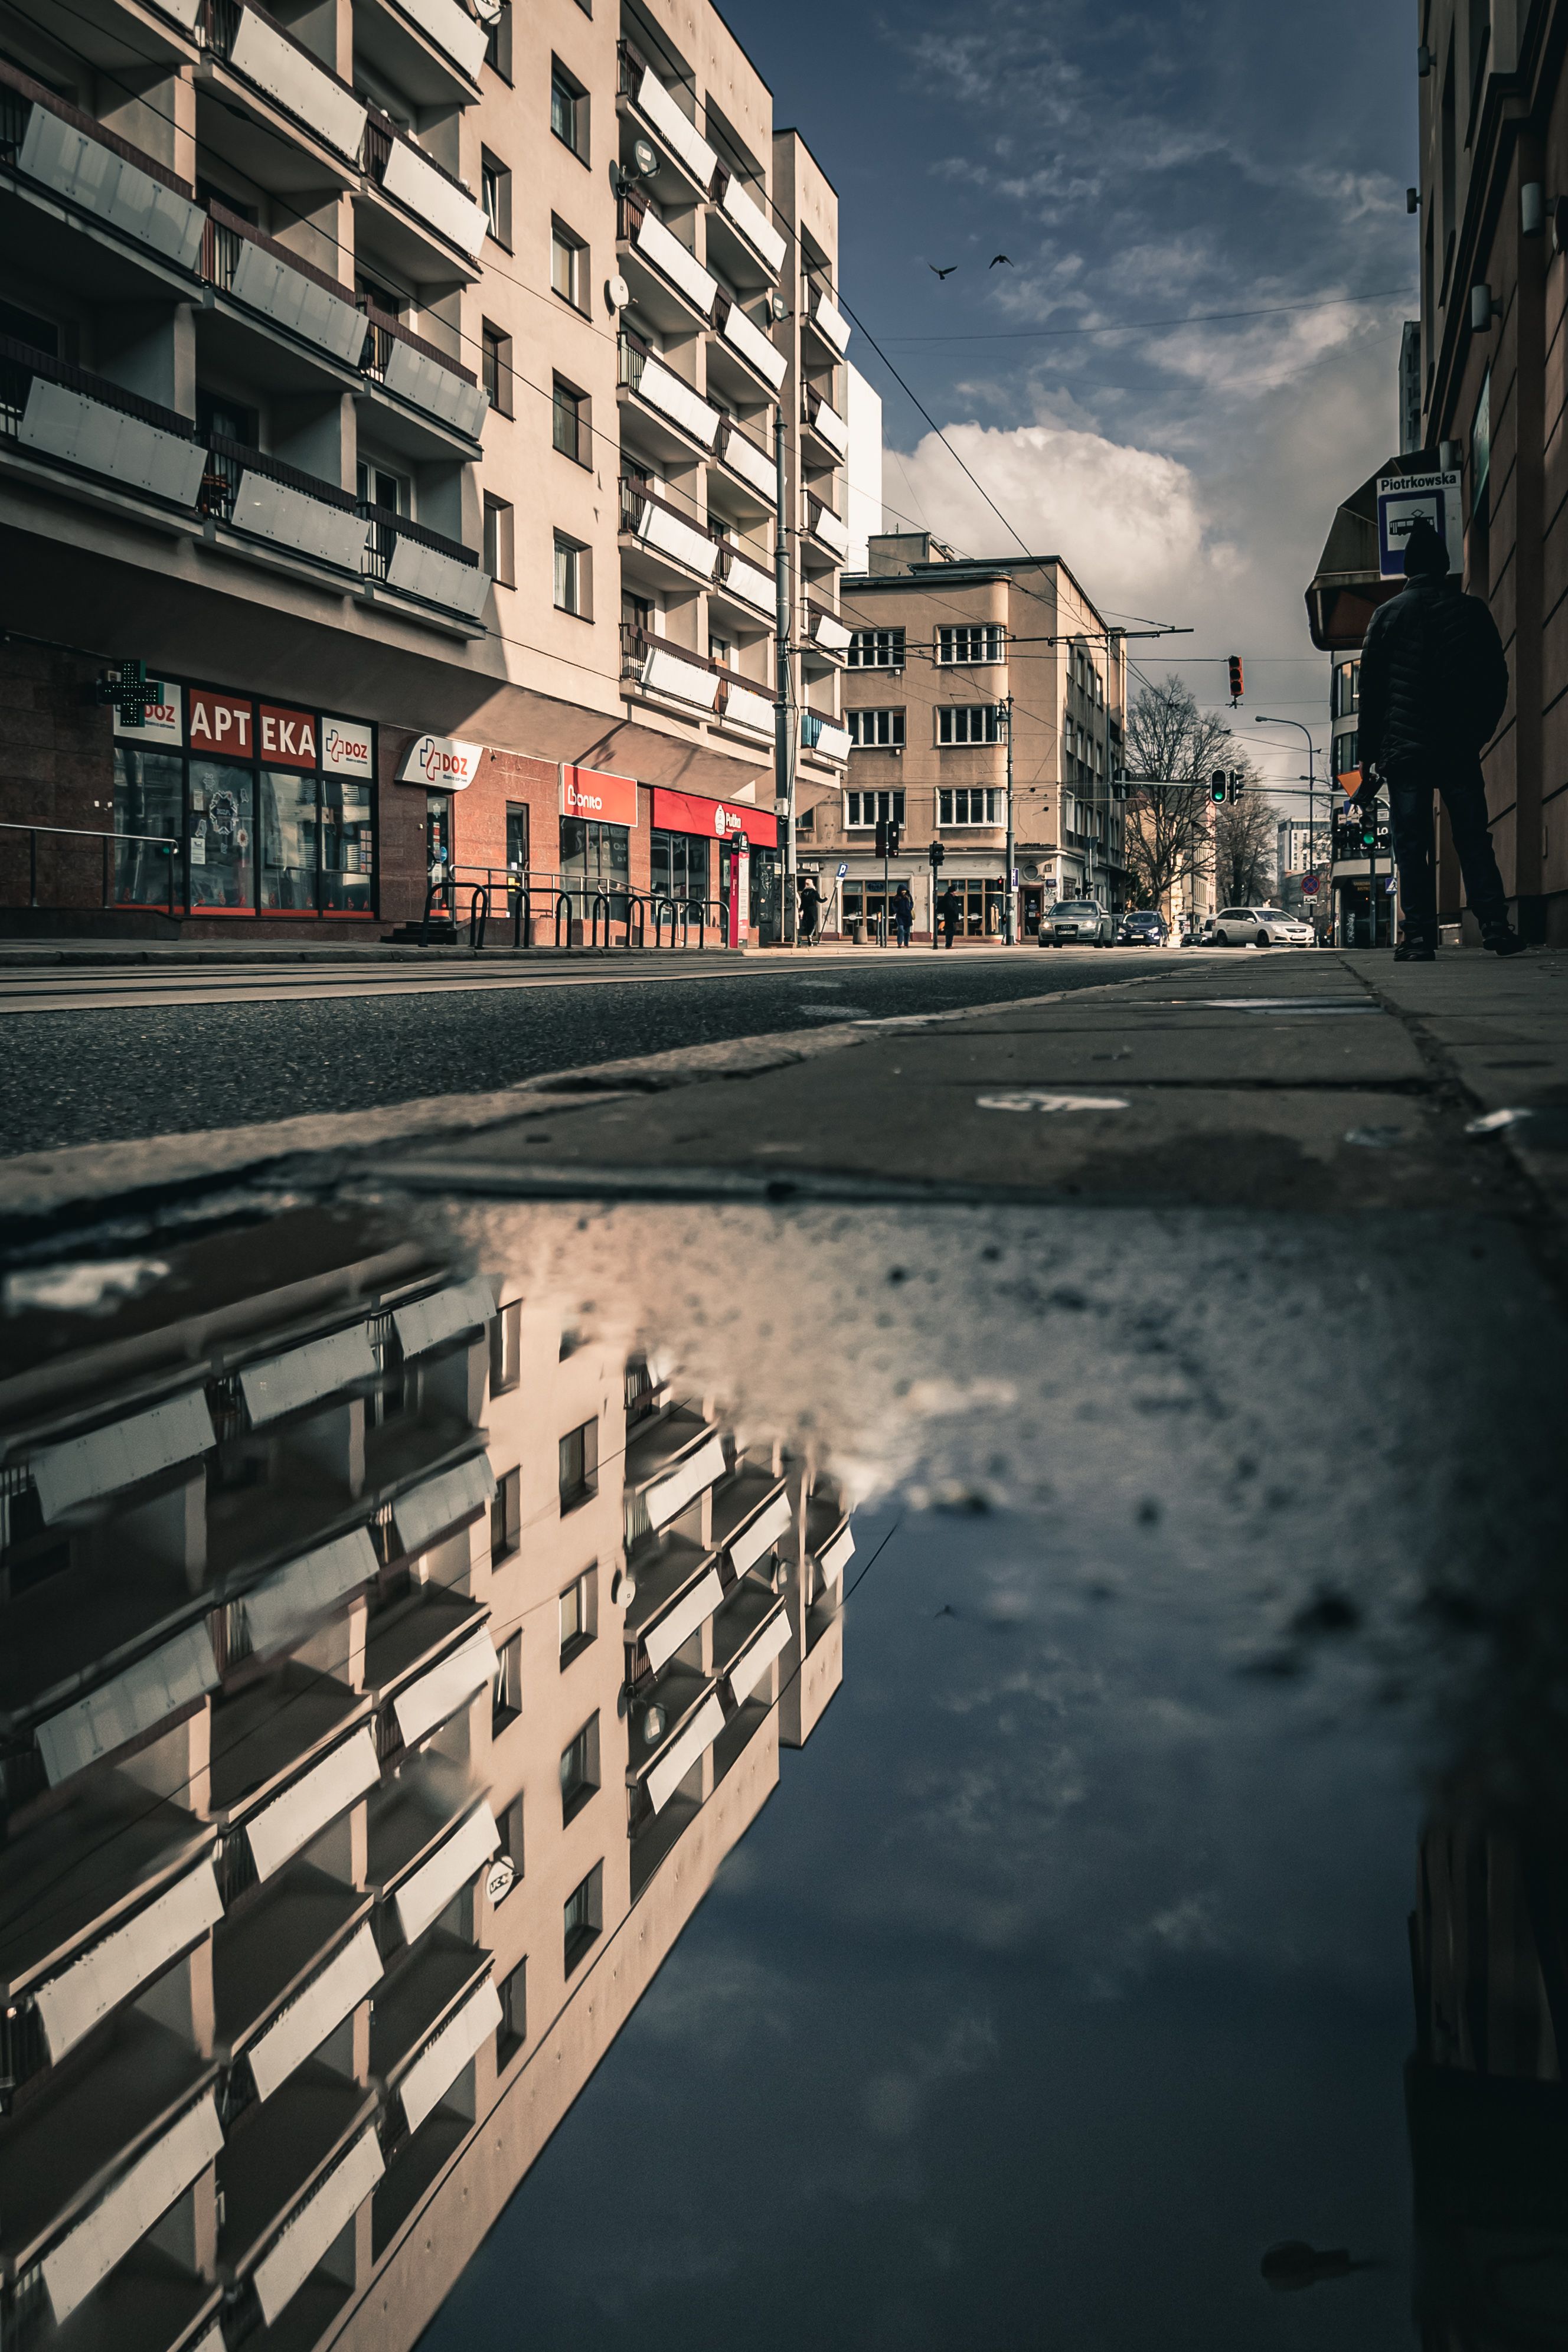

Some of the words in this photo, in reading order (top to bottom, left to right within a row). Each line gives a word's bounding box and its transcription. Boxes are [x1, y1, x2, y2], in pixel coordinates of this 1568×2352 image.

[1381, 473, 1456, 491] Piotrkowska
[345, 741, 367, 759] DOZ
[443, 753, 467, 775] DOZ
[838, 865, 847, 876] P
